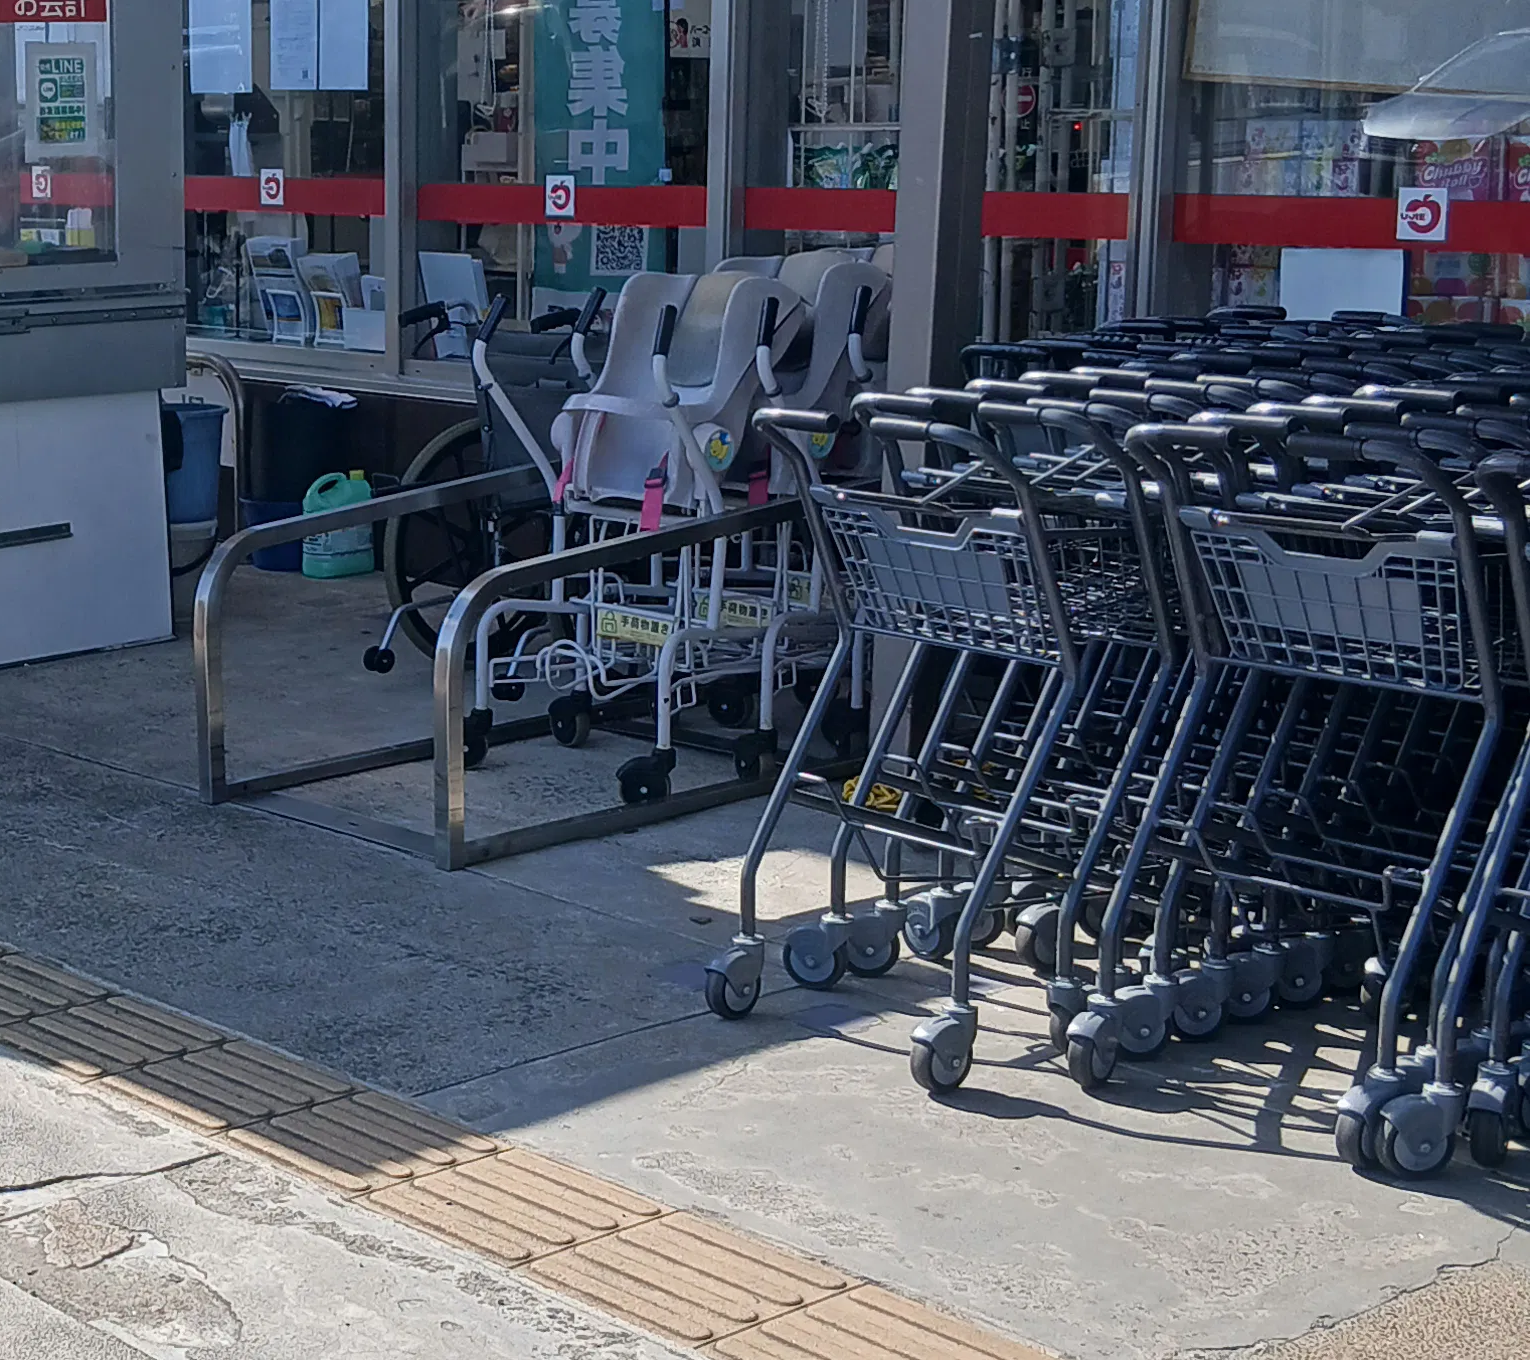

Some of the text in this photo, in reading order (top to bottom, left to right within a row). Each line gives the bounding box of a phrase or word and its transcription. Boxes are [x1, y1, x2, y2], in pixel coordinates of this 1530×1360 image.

[1423, 158, 1484, 181] Chubby
[620, 613, 669, 635] 手荷物置き
